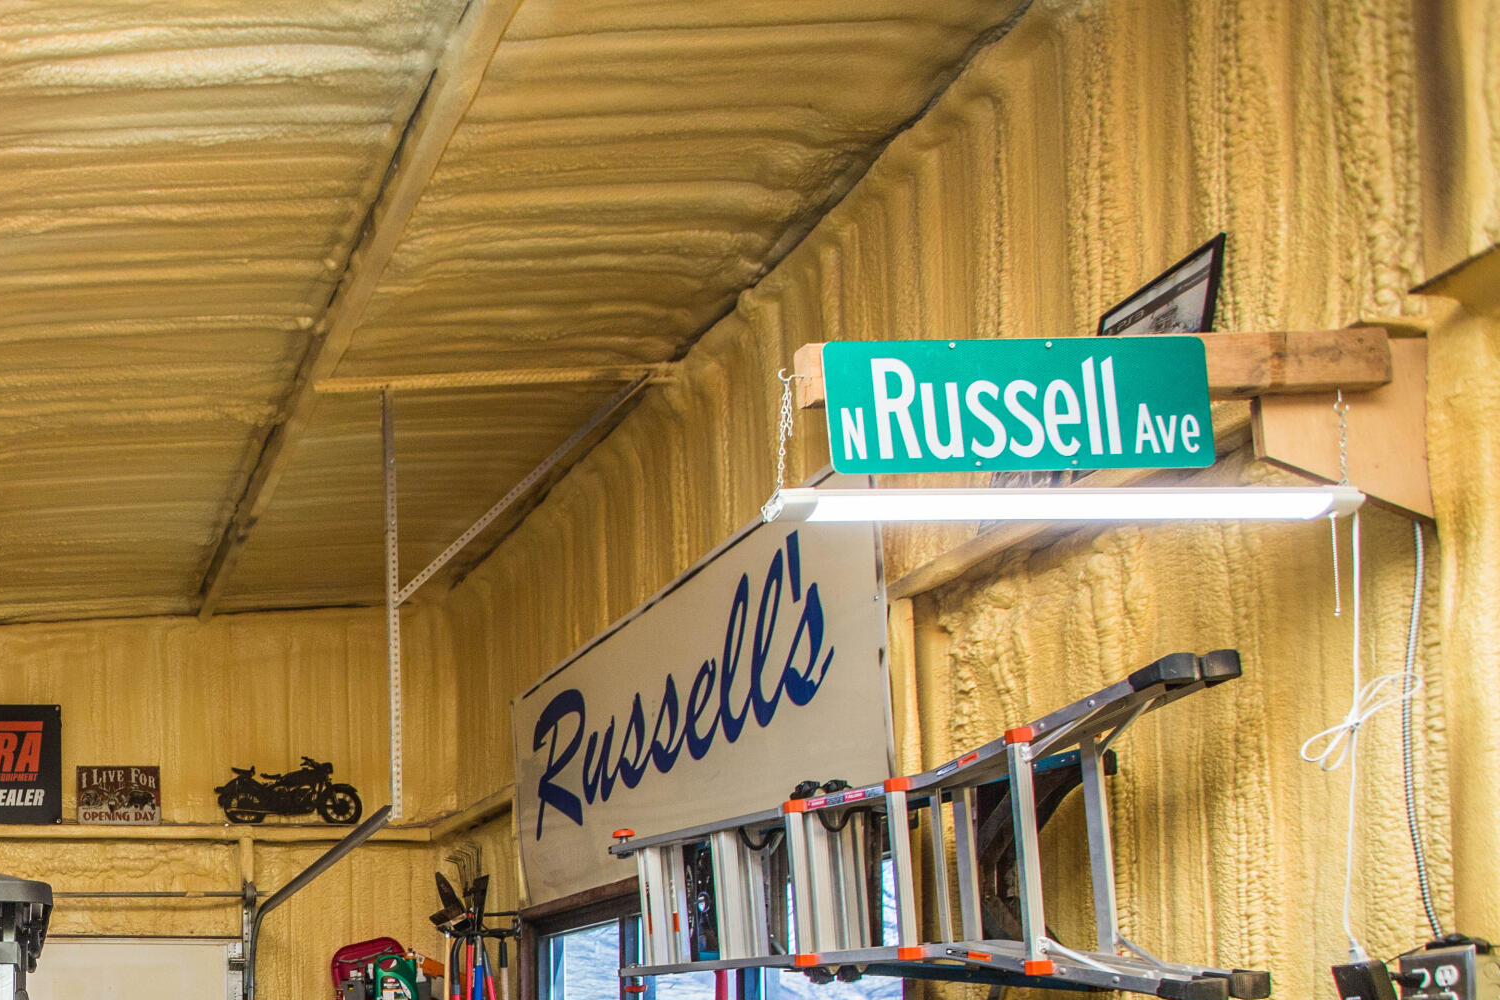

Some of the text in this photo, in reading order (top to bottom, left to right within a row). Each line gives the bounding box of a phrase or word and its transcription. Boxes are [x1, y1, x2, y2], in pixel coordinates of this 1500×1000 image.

[840, 356, 1201, 460] N Russell Ave
[533, 529, 834, 842] Russell's
[82, 772, 87, 788] I
[83, 811, 156, 821] OPENING DAY
